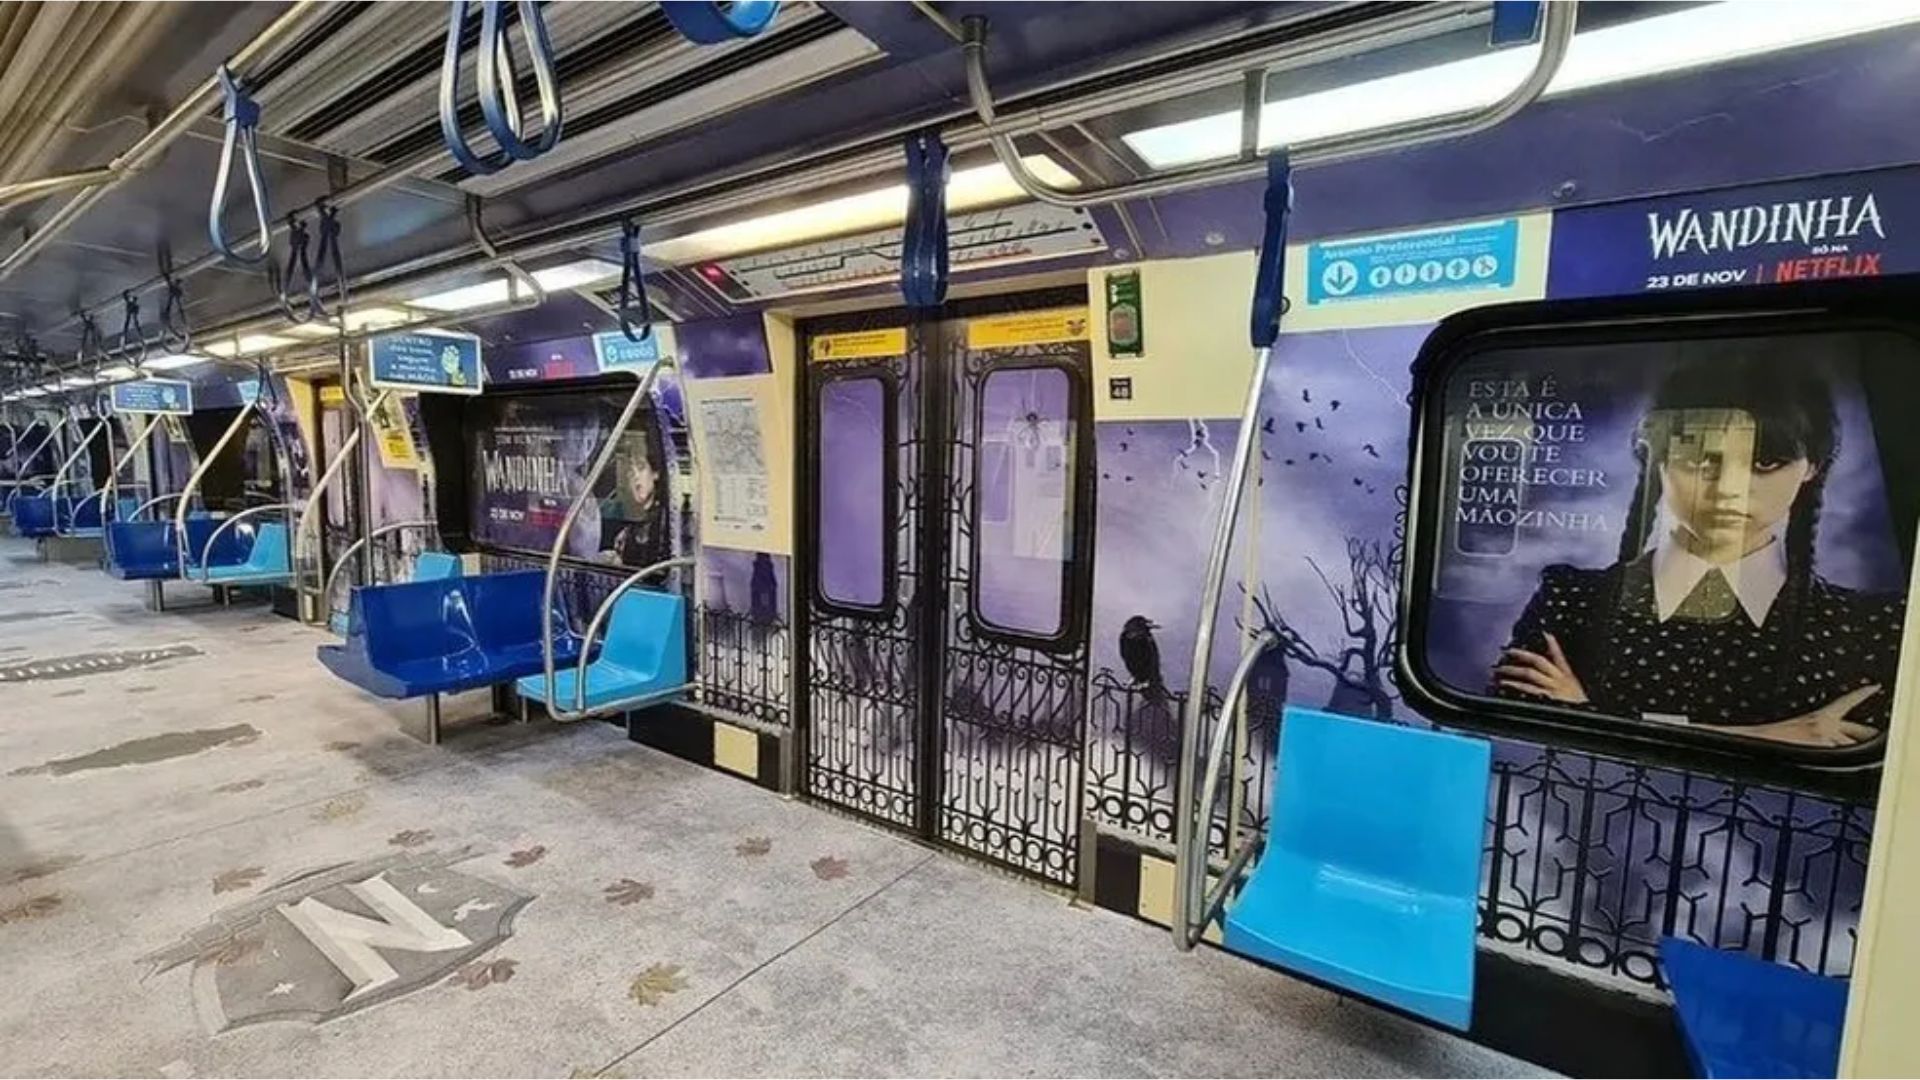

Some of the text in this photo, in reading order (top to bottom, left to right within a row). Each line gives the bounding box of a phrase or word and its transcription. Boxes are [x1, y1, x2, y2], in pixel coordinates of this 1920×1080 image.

[1648, 193, 1886, 259] WANDINHA
[1646, 253, 1882, 289] 23 DE NOV NETFLIX
[1470, 373, 1557, 398] ESTA É
[1466, 398, 1582, 421] A ÚNICA
[1523, 424, 1585, 444] QUE
[1464, 444, 1561, 462] VOU TE
[483, 449, 571, 499] WANDINHA
[1460, 465, 1608, 488] OFERECER
[1459, 486, 1518, 504] UMA
[1455, 504, 1608, 532] MÃOZINHA
[278, 870, 472, 1001] N
